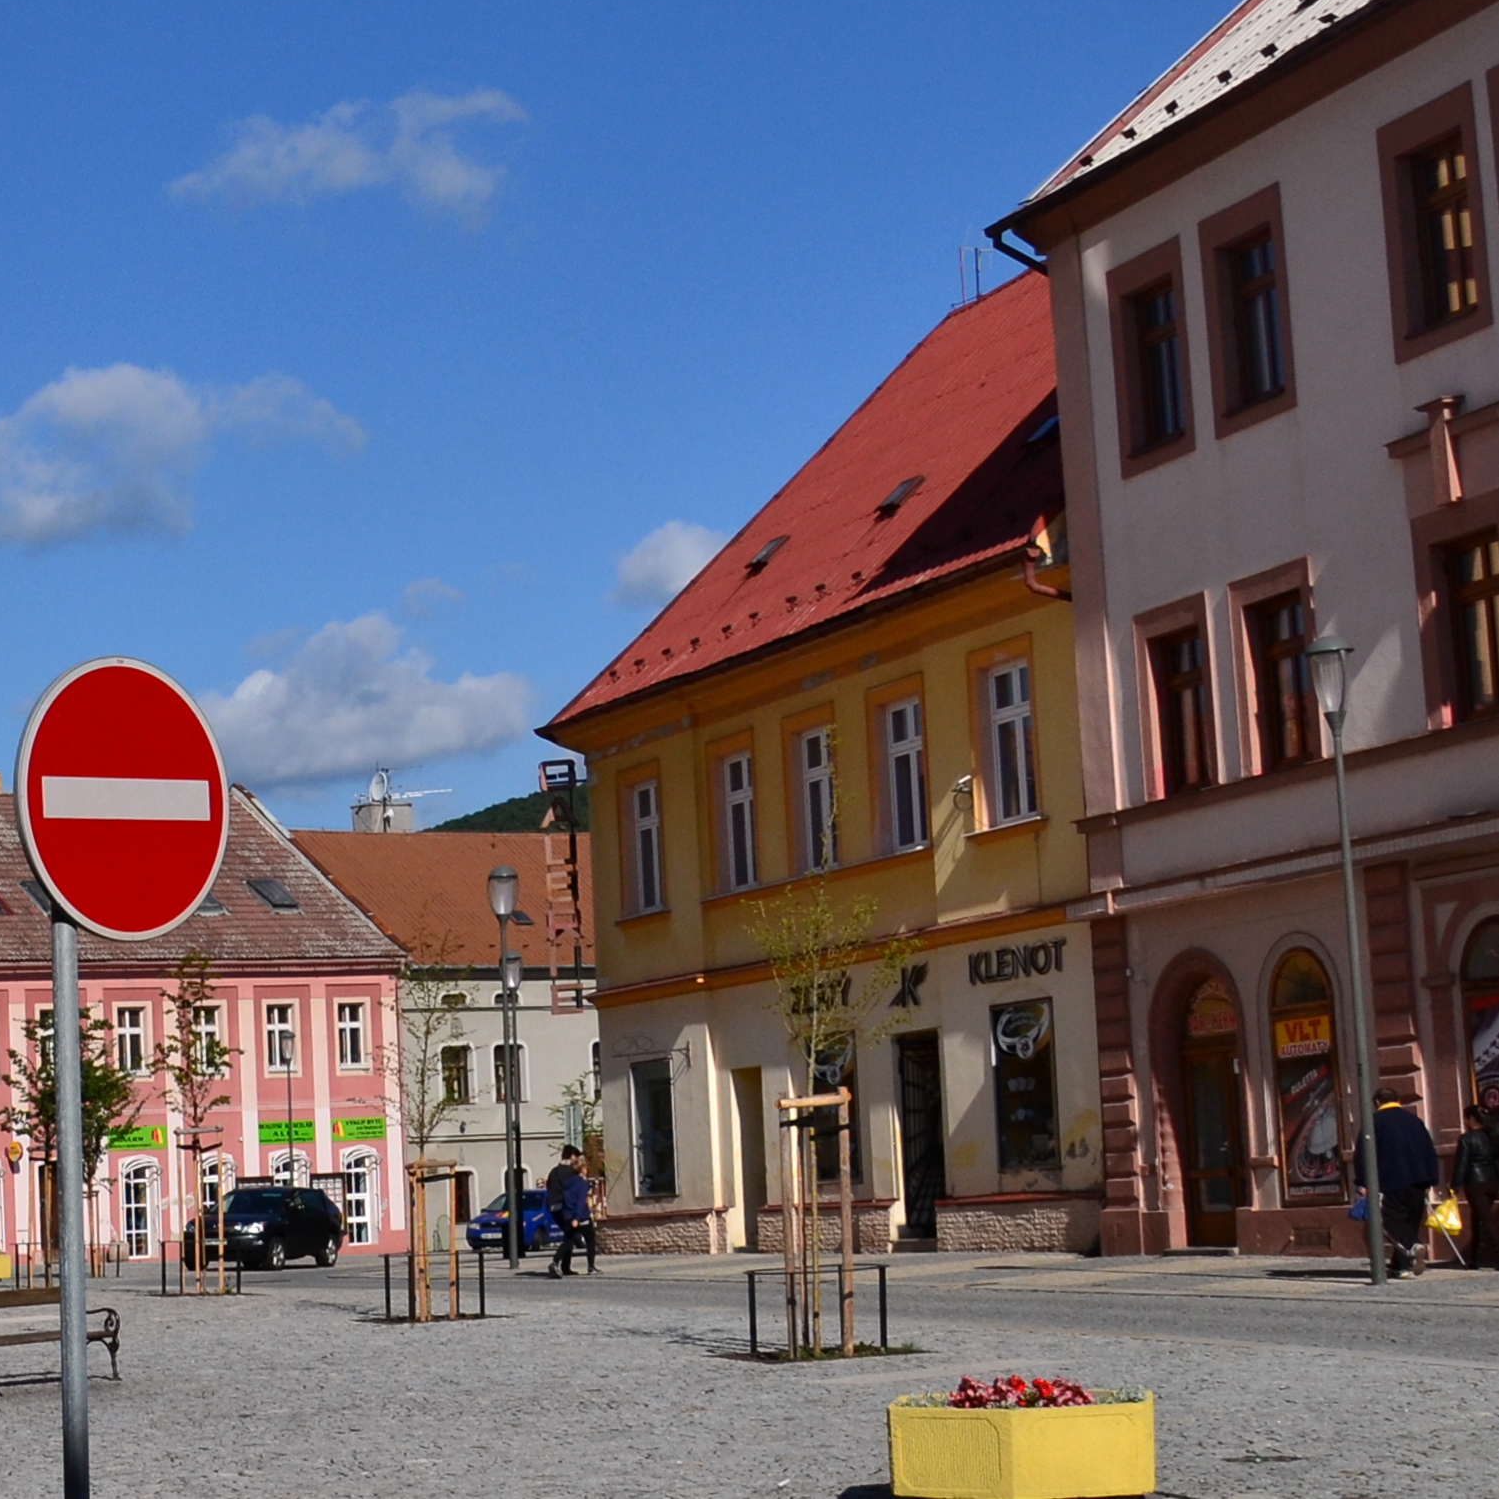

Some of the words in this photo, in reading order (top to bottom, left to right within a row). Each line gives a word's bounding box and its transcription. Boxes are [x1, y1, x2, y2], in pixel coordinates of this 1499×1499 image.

[968, 936, 1068, 985] KLENOT
[1284, 1018, 1322, 1042] VLT
[1279, 1040, 1331, 1058] AUTOMATY
